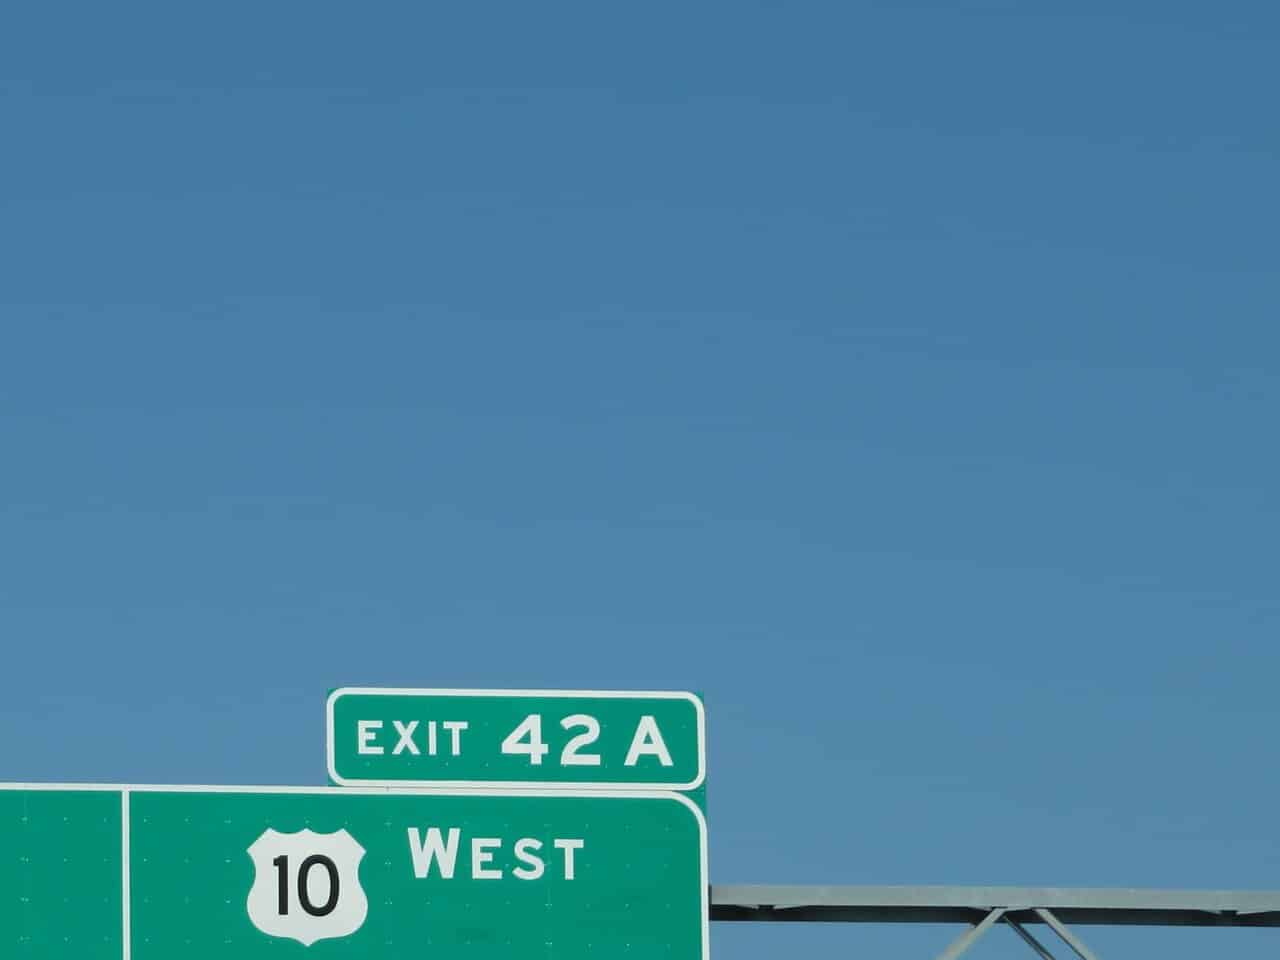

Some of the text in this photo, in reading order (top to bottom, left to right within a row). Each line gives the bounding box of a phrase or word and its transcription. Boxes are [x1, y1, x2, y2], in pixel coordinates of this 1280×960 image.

[357, 714, 674, 766] EXIT 42 A
[407, 827, 585, 880] WEST
[272, 854, 340, 918] 10
